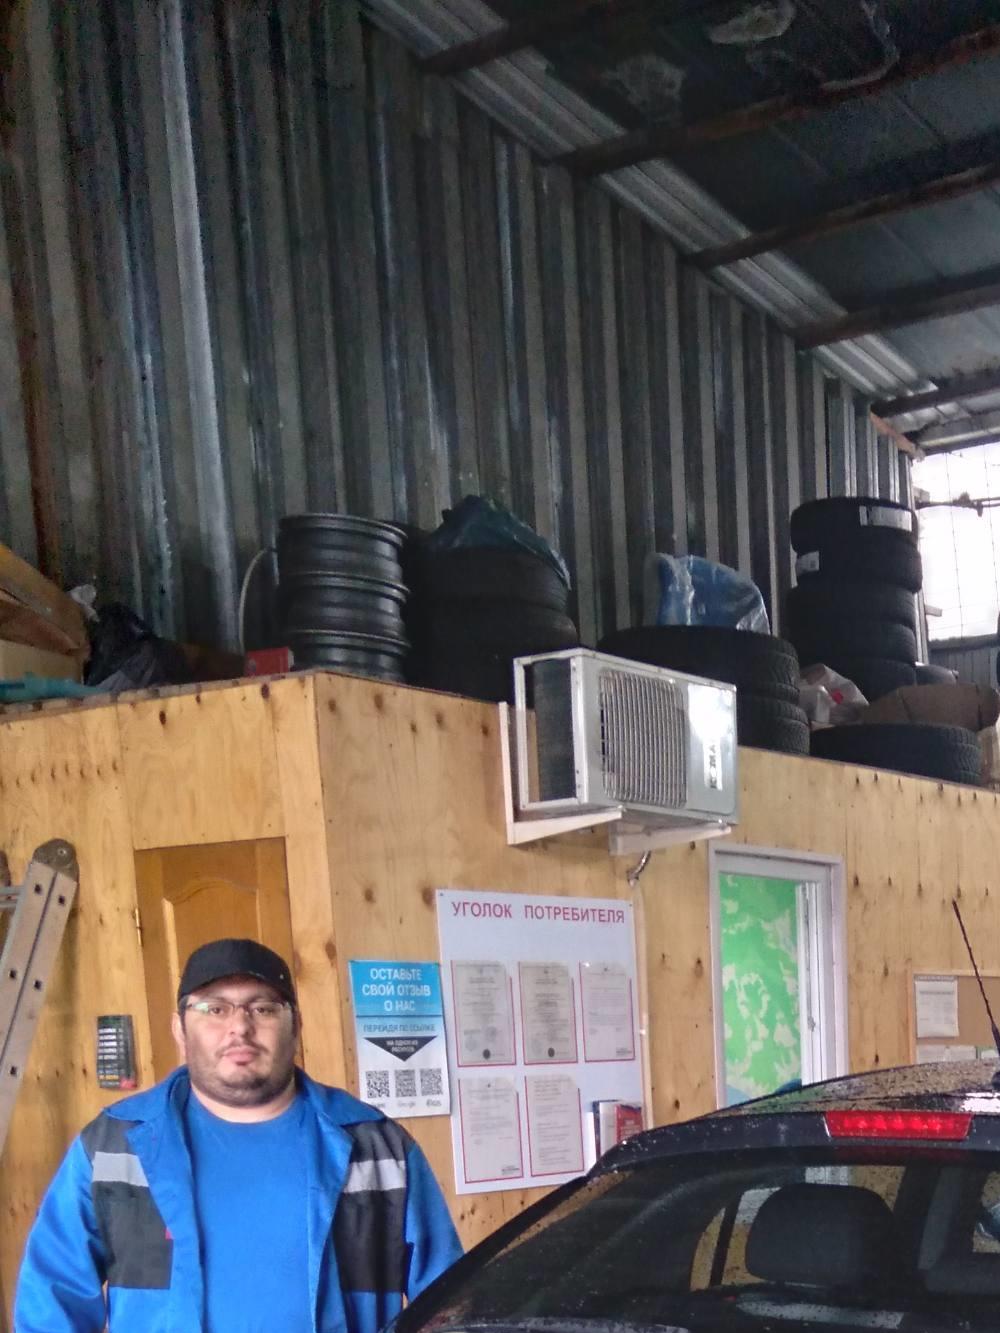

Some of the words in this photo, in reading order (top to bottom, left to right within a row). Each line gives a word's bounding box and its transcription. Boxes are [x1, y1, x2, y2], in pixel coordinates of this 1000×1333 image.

[451, 901, 513, 918] УГОЛОК
[524, 904, 625, 924] ПОТРЕБИТЕЛЯ
[370, 967, 422, 981] ОСТАВЬТЕ
[362, 982, 395, 996] СВОЙ
[397, 984, 432, 997] ОТЗЫВ
[395, 1000, 416, 1012] НАС
